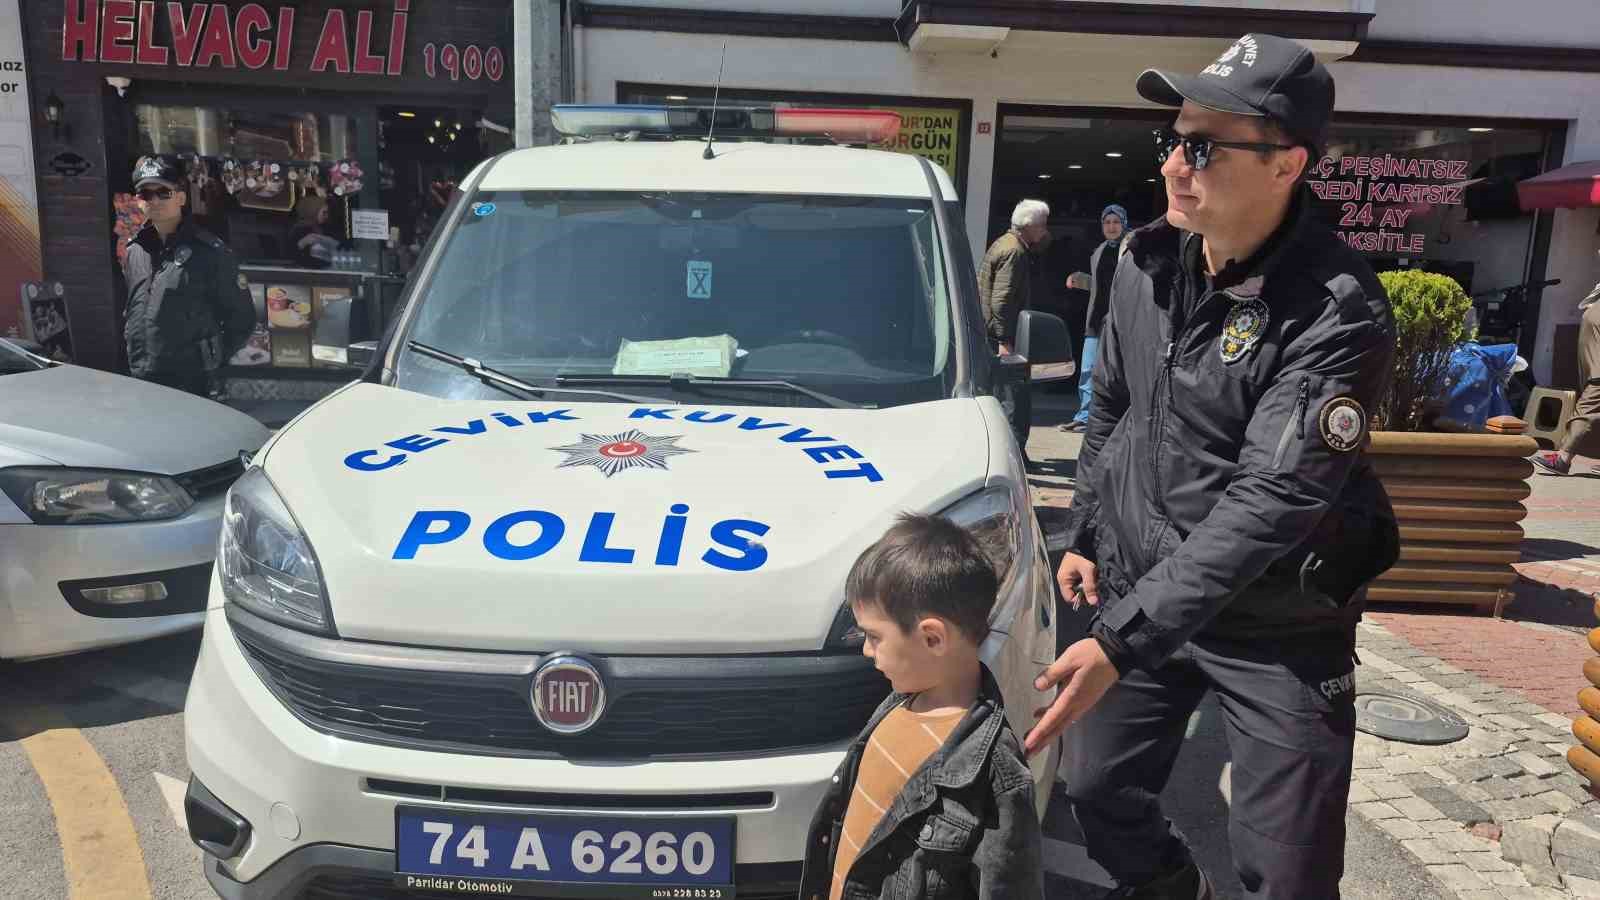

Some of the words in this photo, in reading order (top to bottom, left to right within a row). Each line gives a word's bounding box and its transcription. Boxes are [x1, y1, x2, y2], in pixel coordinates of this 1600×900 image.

[62, 0, 295, 71] HELVACI
[310, 0, 409, 76] ALİ
[423, 42, 503, 81] 1900
[0, 61, 23, 71] az
[898, 115, 953, 129] UR'DAN
[1340, 154, 1469, 180] PEŞİNATSIZ
[1306, 178, 1362, 200] REDİ
[1367, 182, 1464, 205] KARTSIZ
[1338, 202, 1373, 227] 24
[1379, 208, 1410, 228] AY
[1331, 228, 1425, 253] AKSİTLE
[628, 408, 884, 483] KUVVET
[391, 503, 771, 572] POLİS
[548, 680, 590, 713] FIAT
[423, 821, 490, 868] 74
[510, 827, 550, 871] A
[571, 830, 715, 875] 6260
[457, 879, 513, 894] Otomotiv
